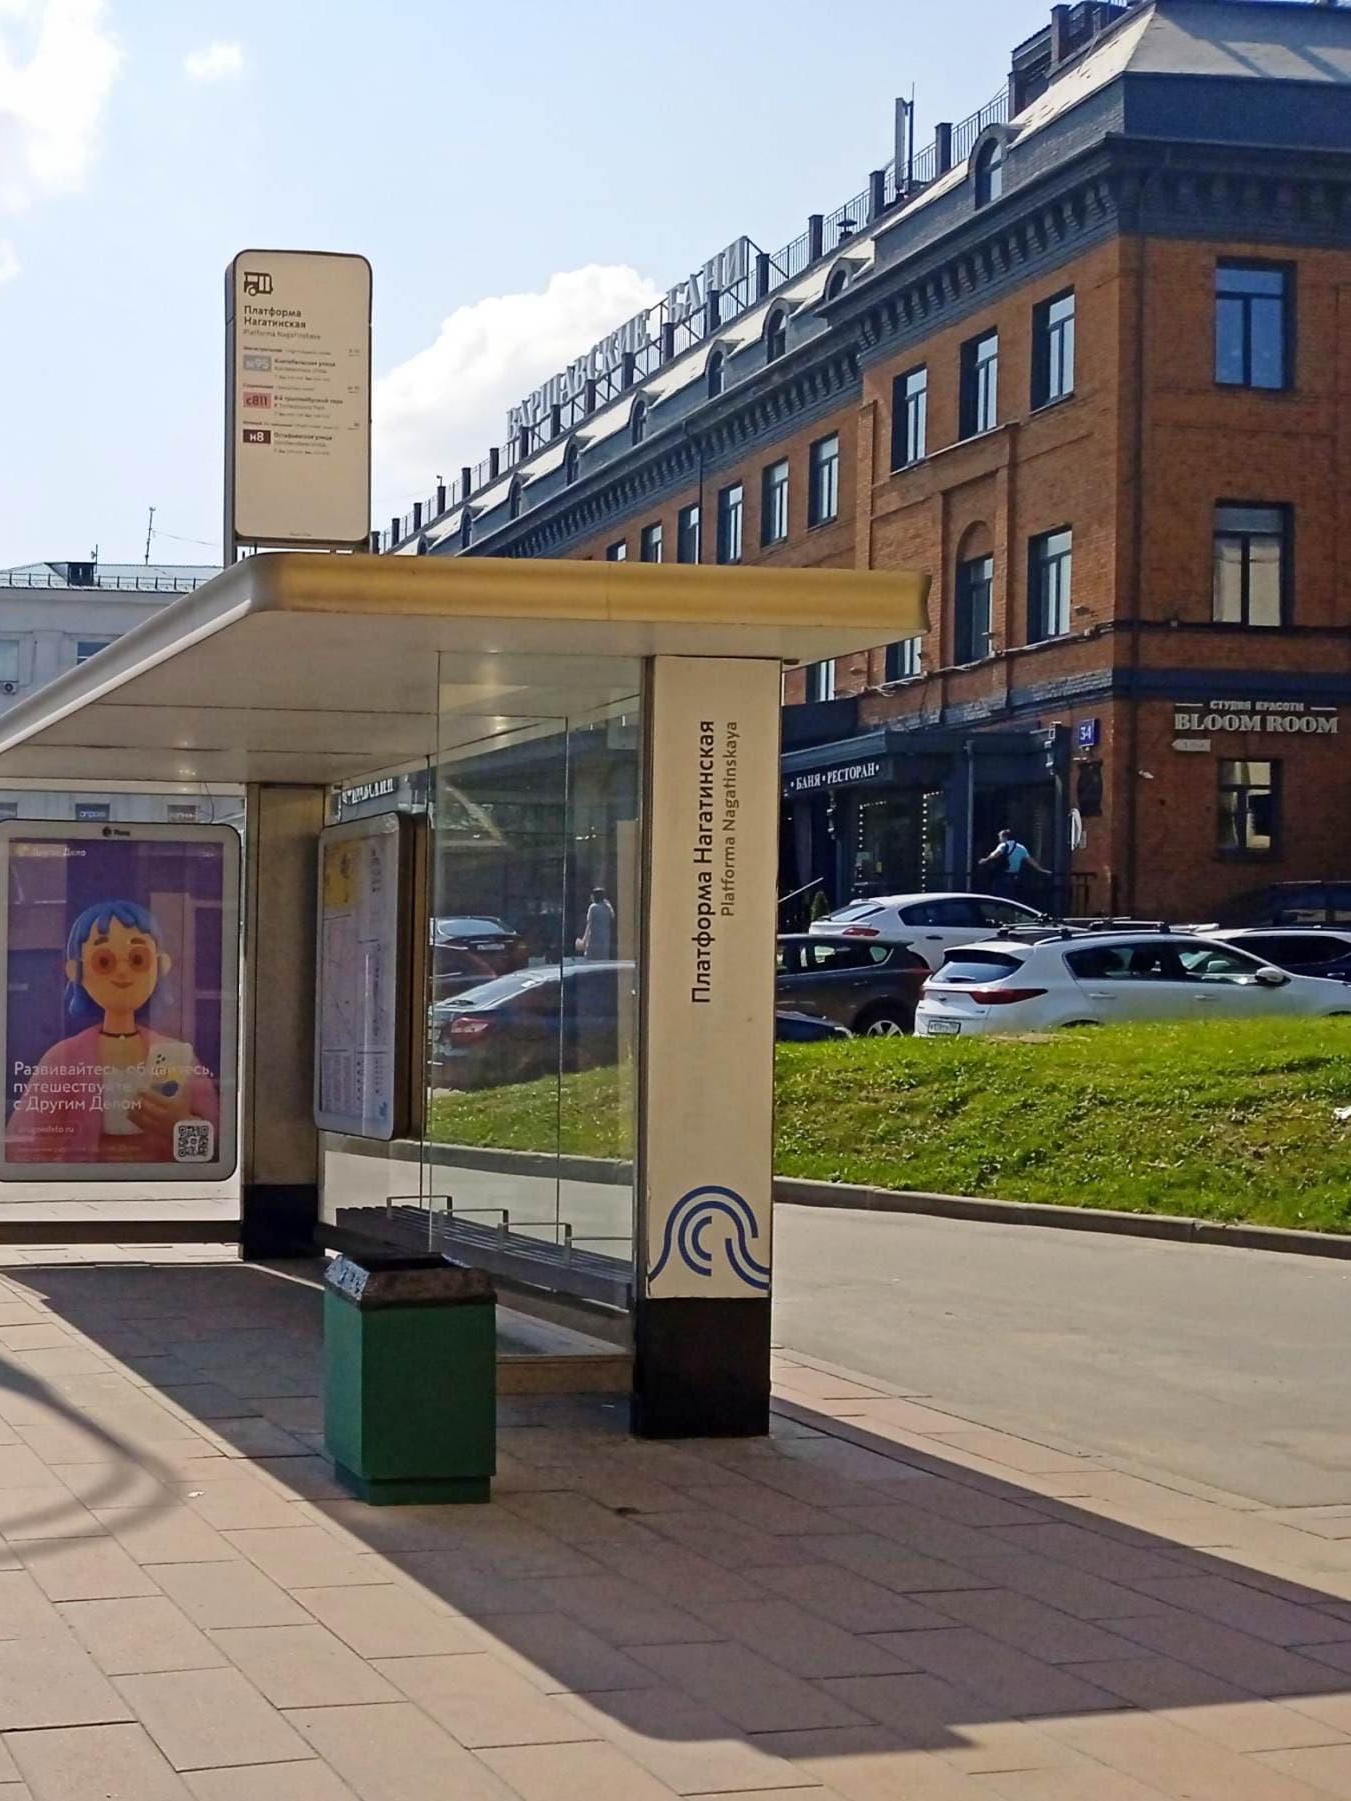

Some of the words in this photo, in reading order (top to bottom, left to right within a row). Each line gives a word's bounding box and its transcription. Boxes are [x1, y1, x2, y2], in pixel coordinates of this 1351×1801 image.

[665, 236, 748, 323] БАНИ
[244, 305, 302, 318] Платформа
[244, 316, 306, 329] Нагатинская
[1209, 700, 1252, 711] СТУДИЯ
[1080, 725, 1092, 741] 34
[1174, 713, 1262, 732] BLOOM
[1265, 715, 1339, 734] ROOM
[721, 721, 741, 832] Nagatinskaya
[796, 773, 821, 790] БАНЯ
[827, 762, 875, 784] РЕСТОРАН
[693, 720, 715, 864] Нагатинская
[721, 836, 738, 917] Platforma
[691, 872, 716, 1003] Платформа
[13, 1101, 21, 1111] с
[25, 1096, 87, 1114] Другим
[89, 1096, 143, 1113] Делом
